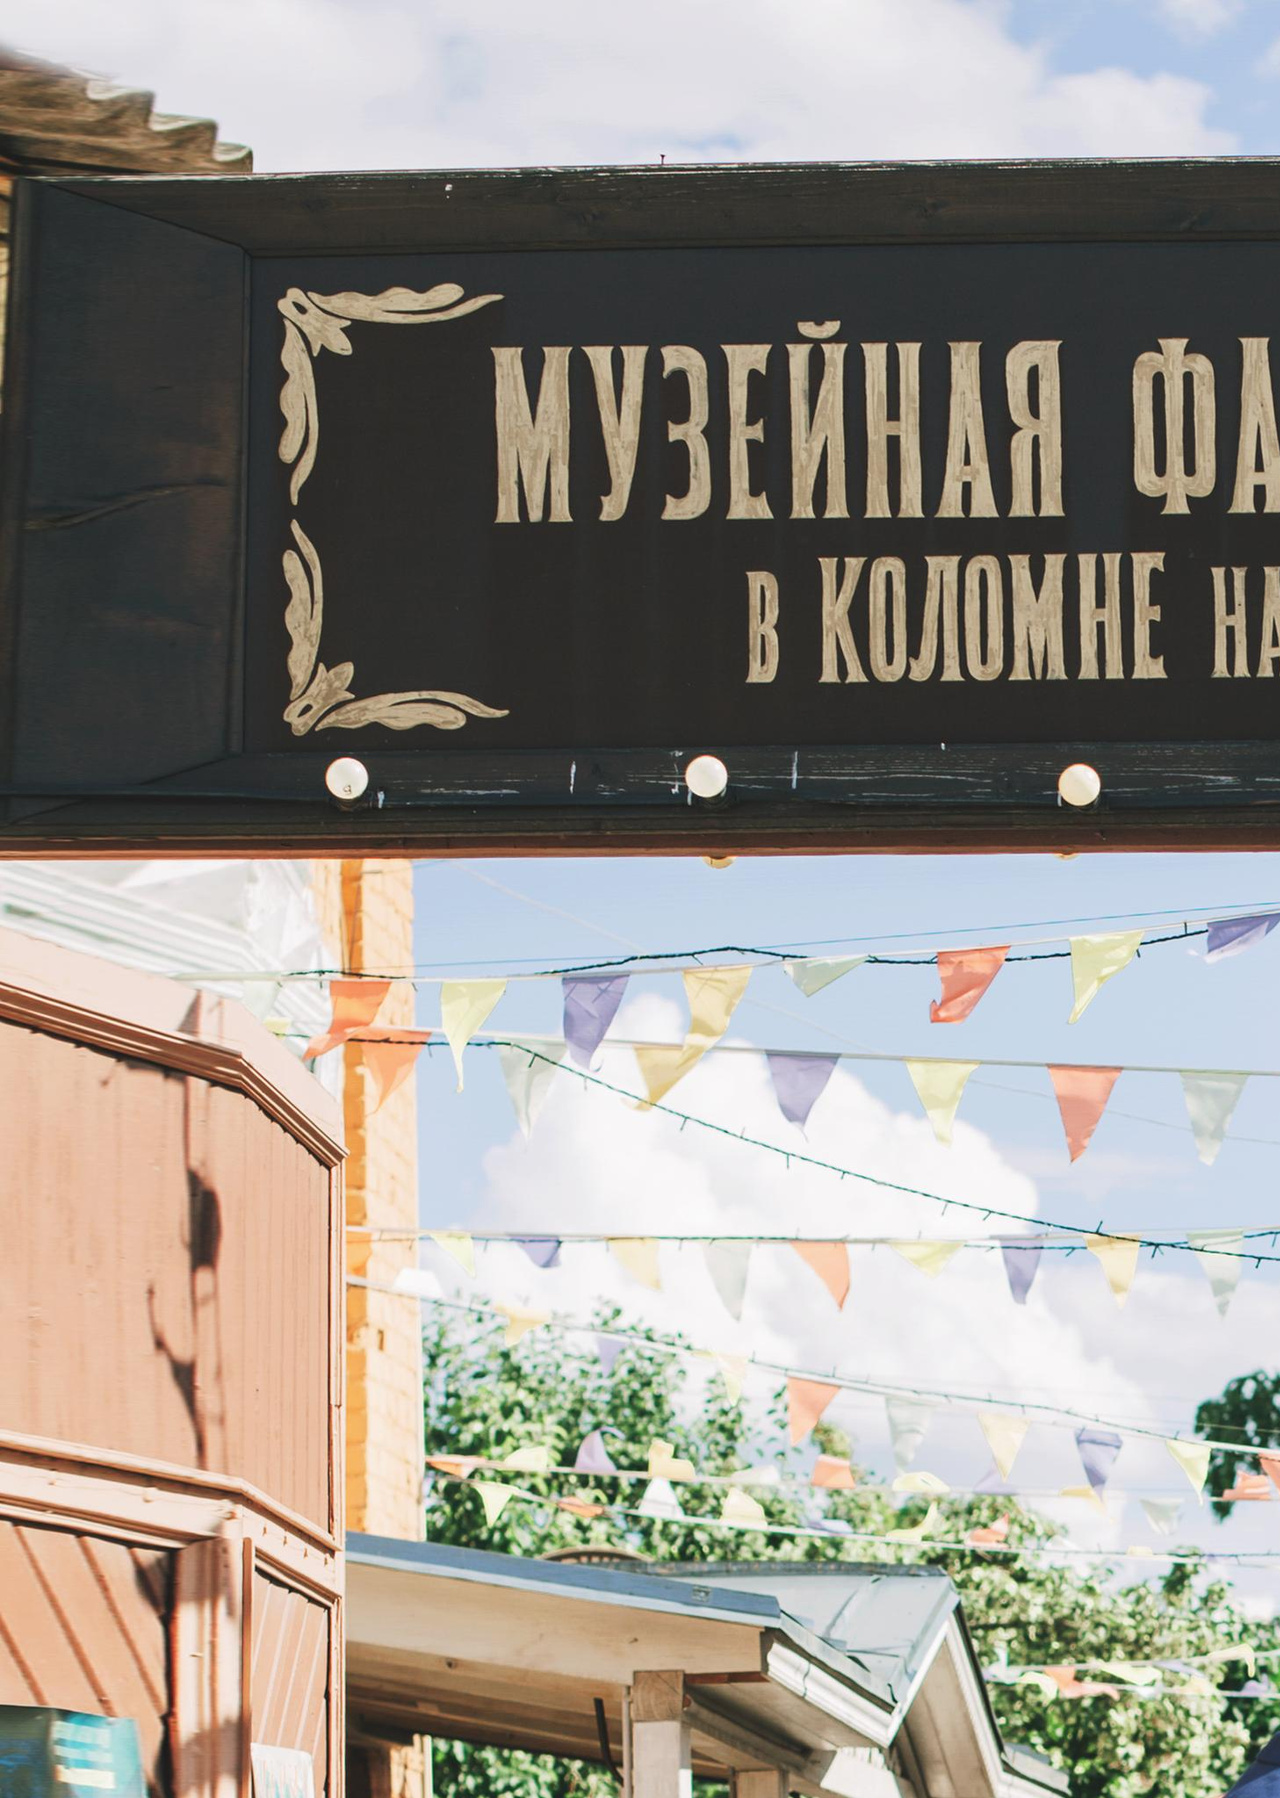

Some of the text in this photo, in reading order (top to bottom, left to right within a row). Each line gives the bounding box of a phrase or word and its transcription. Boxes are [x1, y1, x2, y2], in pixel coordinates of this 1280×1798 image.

[491, 320, 1065, 523] МУЗЕЙНАЯ
[745, 570, 779, 684] В
[817, 551, 1168, 684] КОЛОМНЕ
